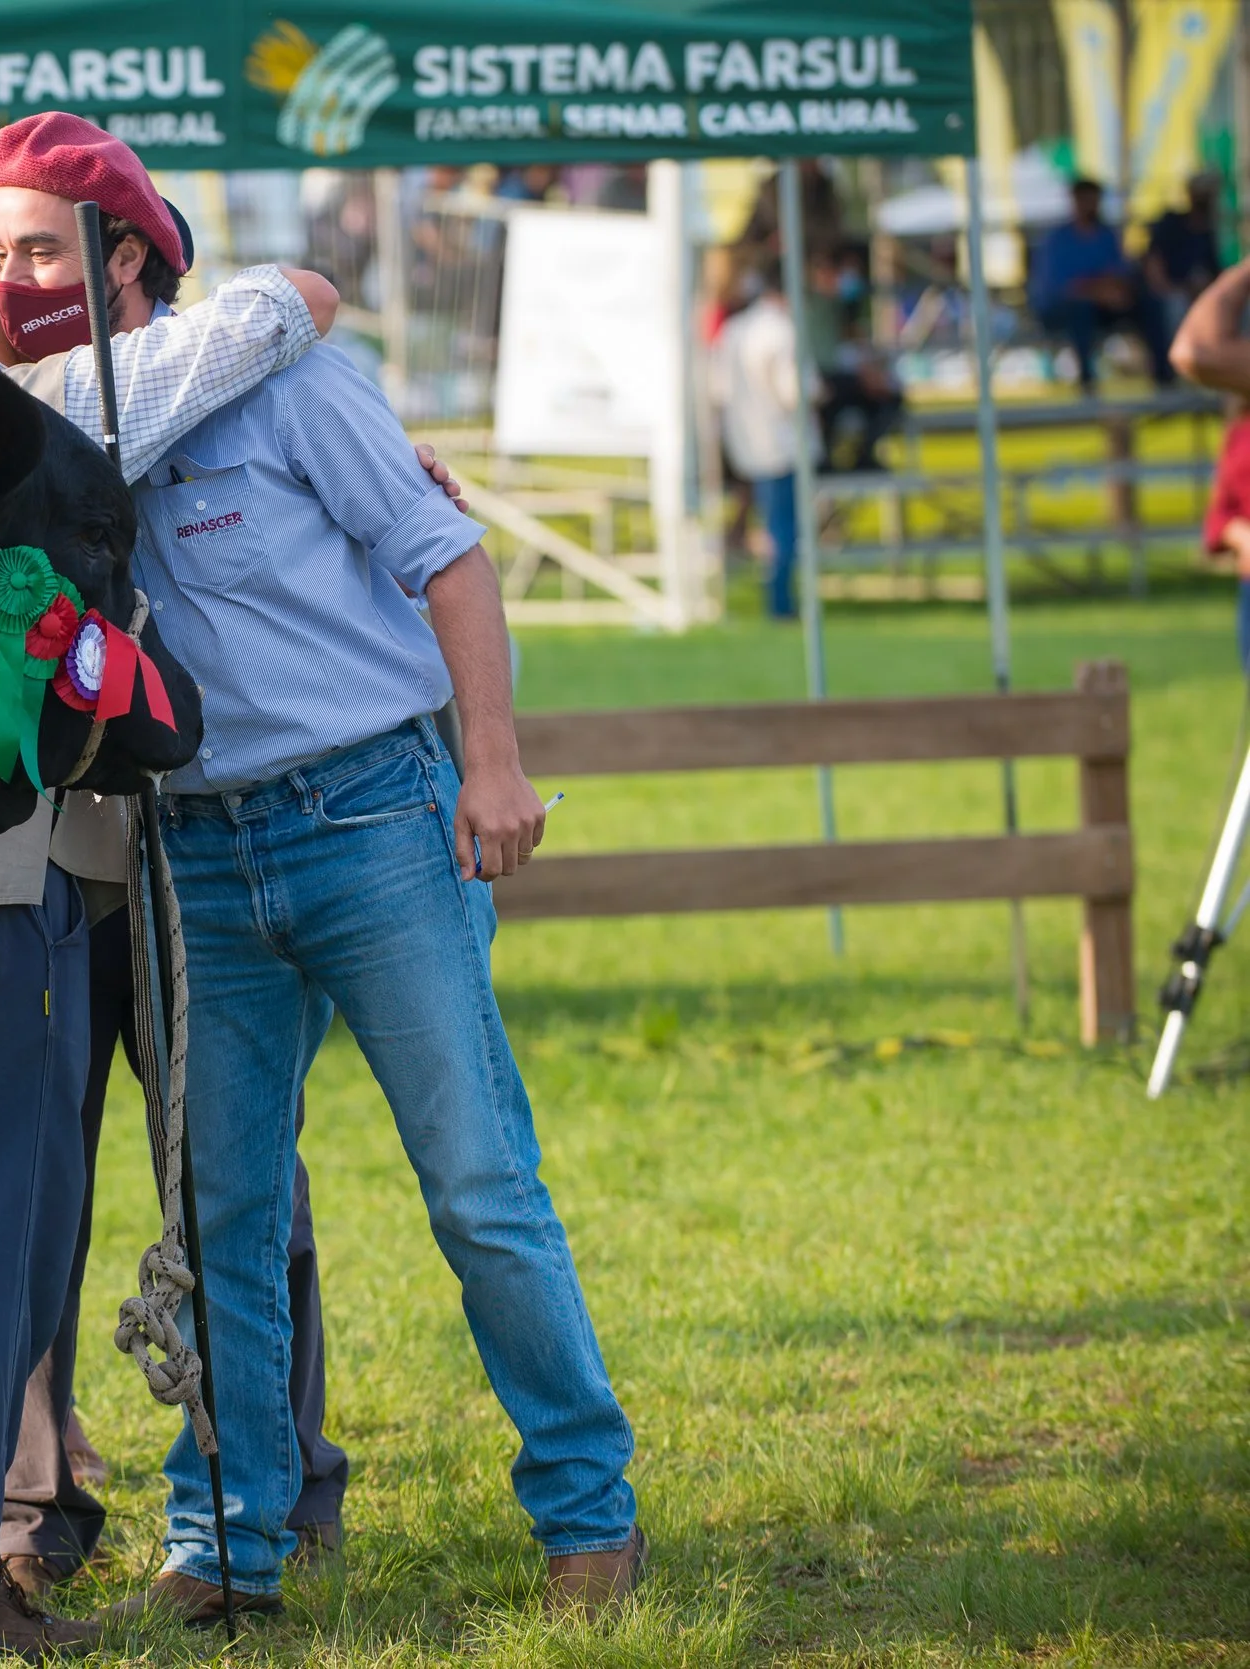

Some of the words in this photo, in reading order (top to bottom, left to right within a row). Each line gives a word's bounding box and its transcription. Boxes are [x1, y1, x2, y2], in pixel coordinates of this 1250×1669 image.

[413, 41, 675, 97] SISTEMA
[684, 35, 916, 92] FARSUL
[106, 110, 226, 147] RURAL
[414, 106, 548, 140] FARSUL
[562, 102, 688, 138] SENAR
[698, 102, 799, 136] CASA
[800, 99, 918, 133] RURAL
[21, 304, 85, 334] RENASCER
[176, 511, 244, 540] RENASCER
